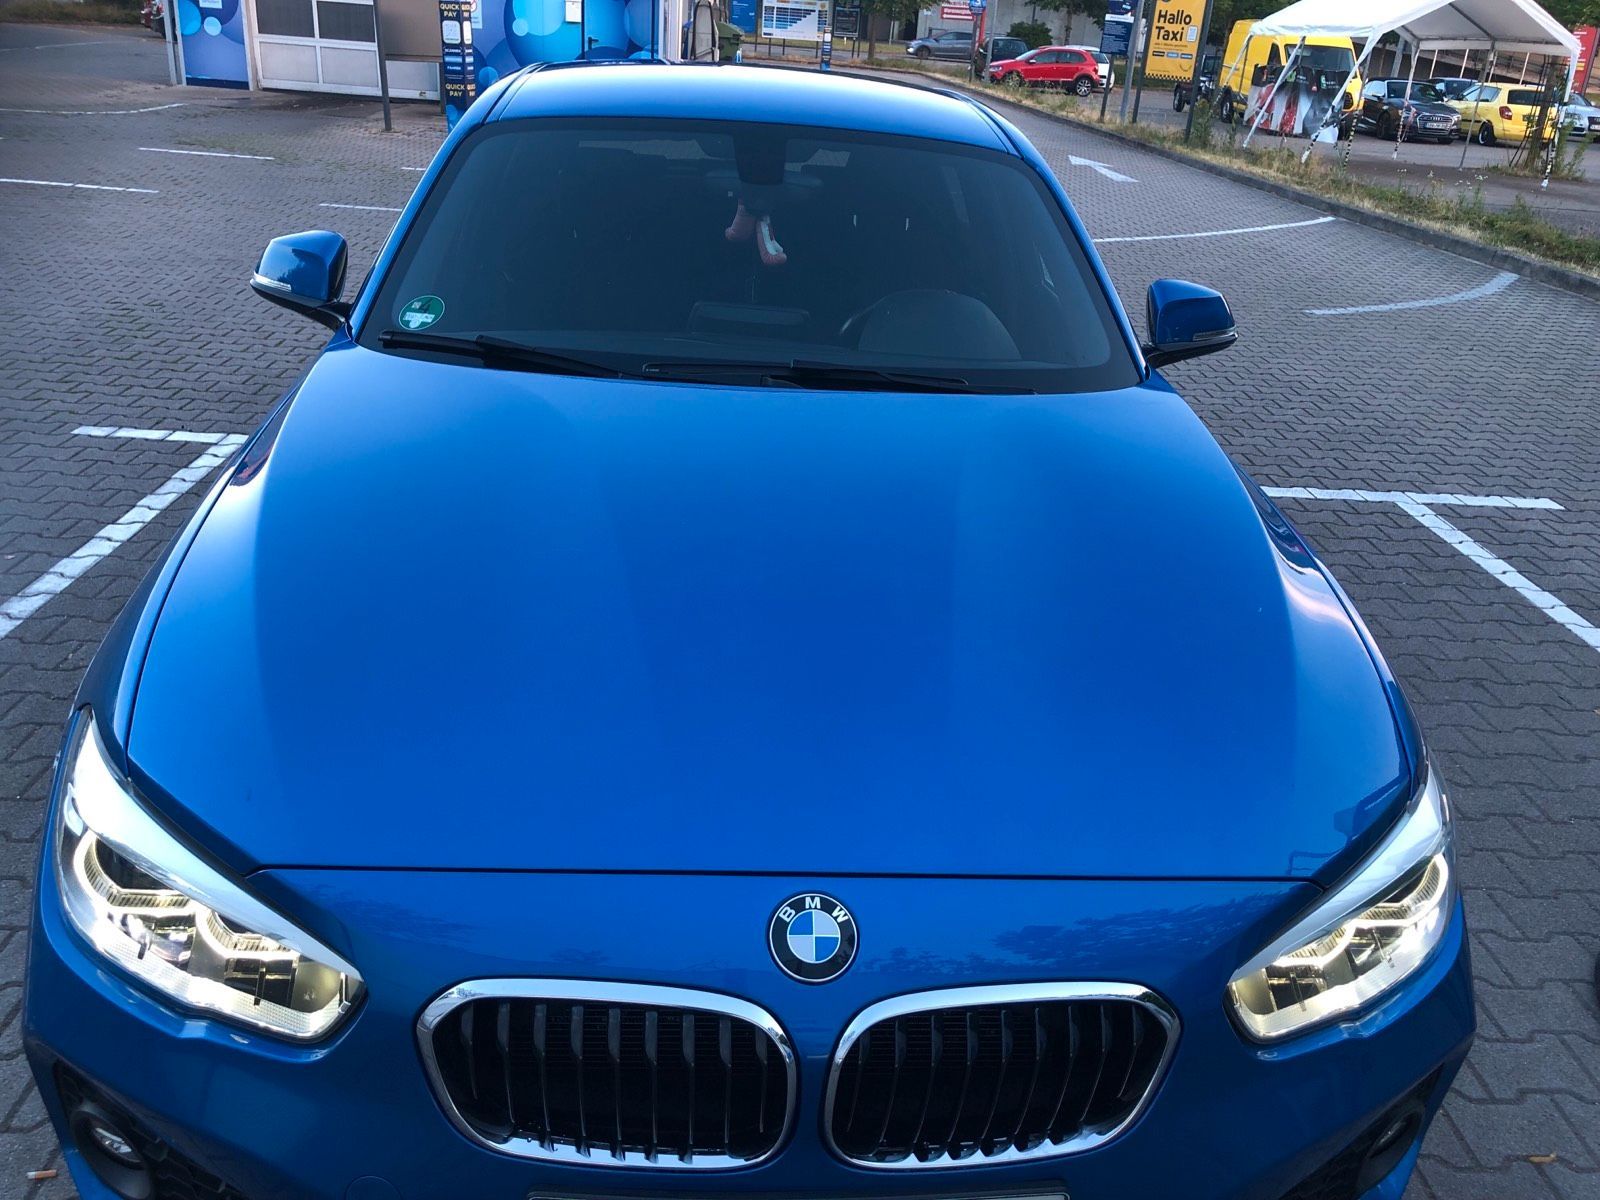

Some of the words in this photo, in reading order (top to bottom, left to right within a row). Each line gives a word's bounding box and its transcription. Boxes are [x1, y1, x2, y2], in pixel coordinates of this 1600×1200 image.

[1157, 9, 1192, 25] Hallo
[1155, 26, 1184, 41] Taxi
[778, 896, 849, 923] BMW
